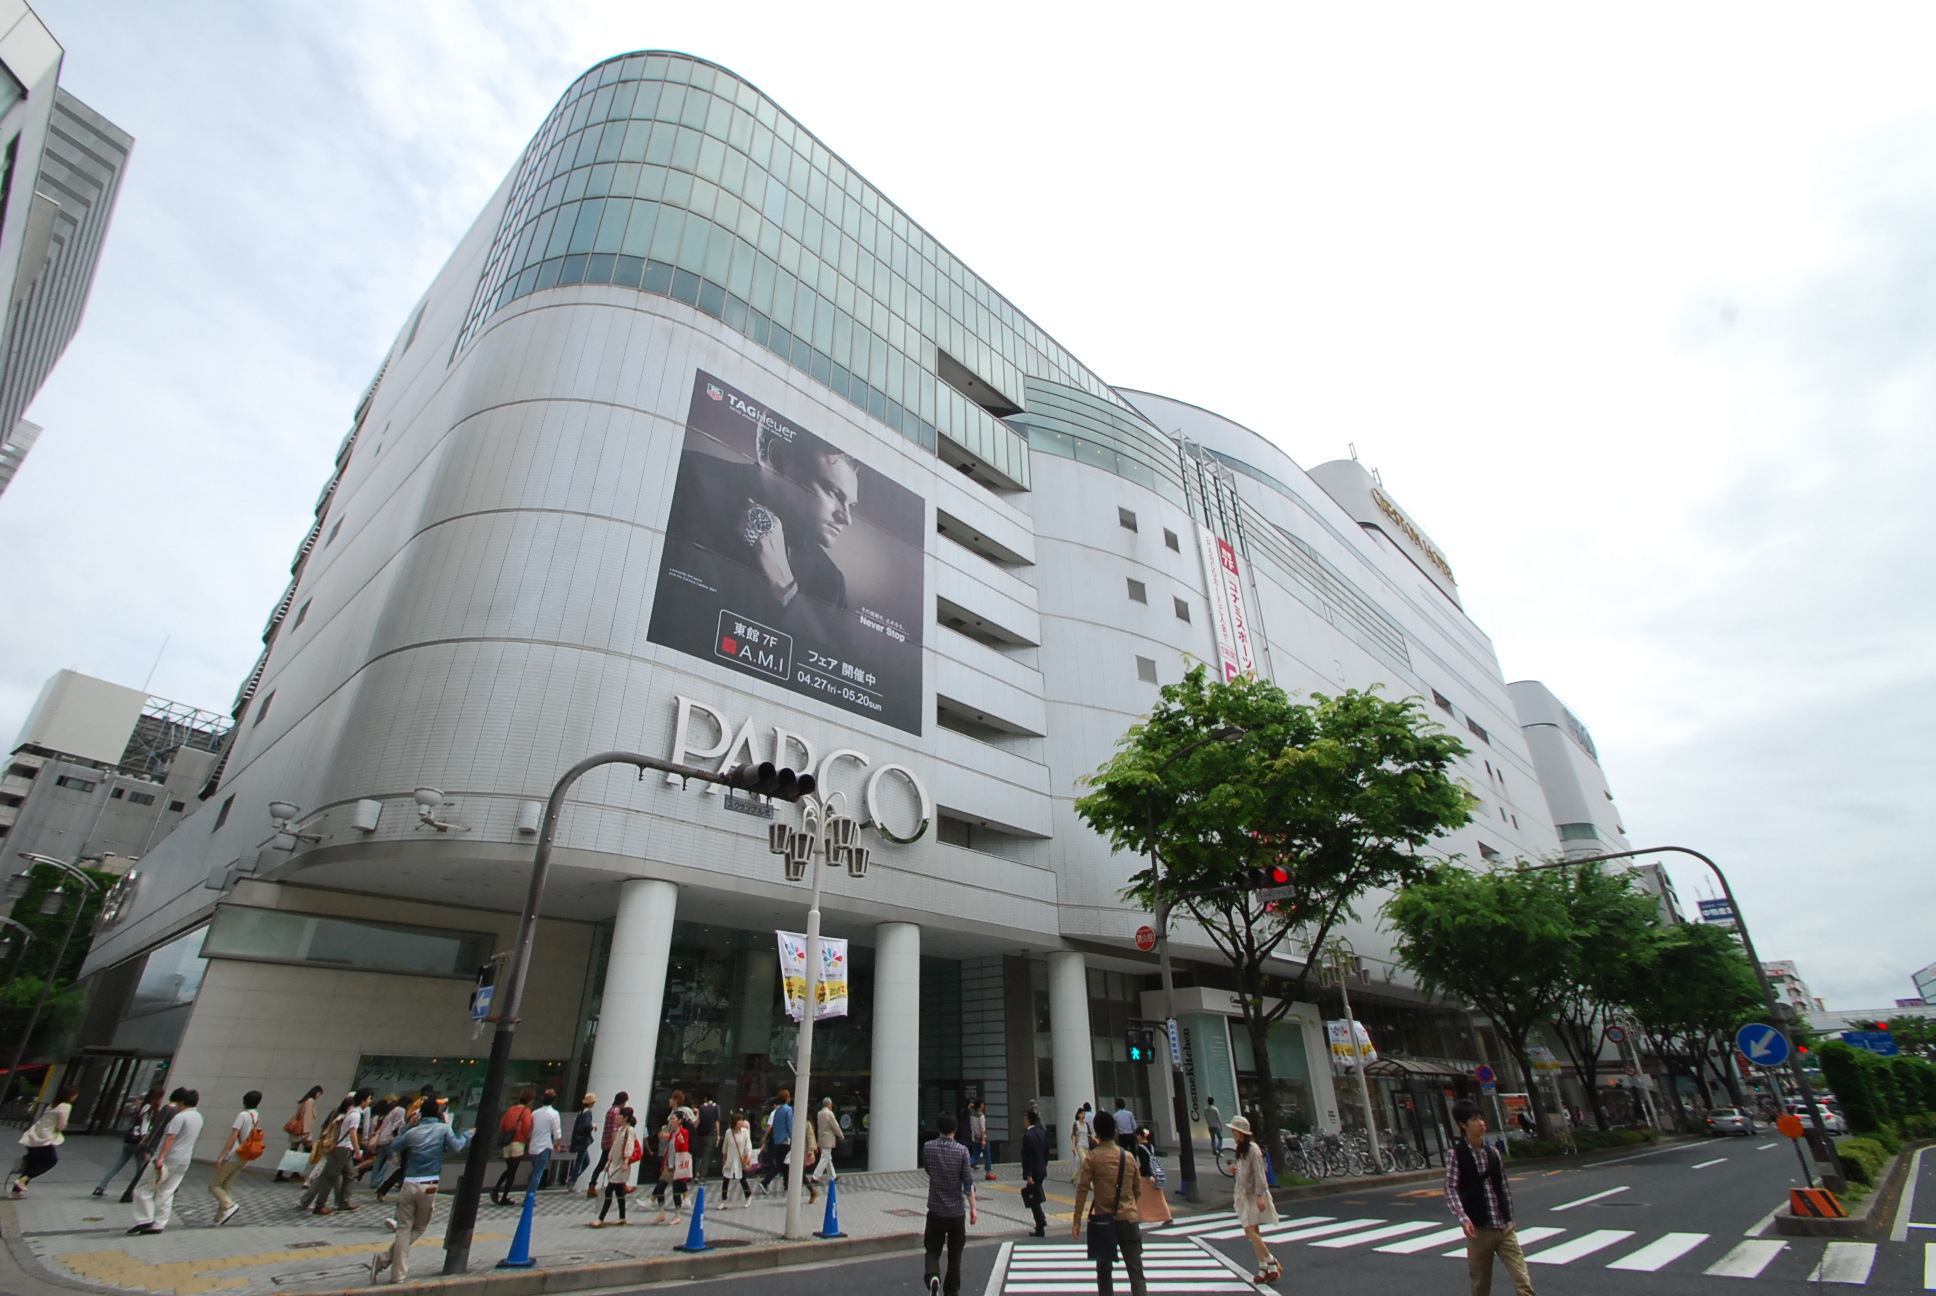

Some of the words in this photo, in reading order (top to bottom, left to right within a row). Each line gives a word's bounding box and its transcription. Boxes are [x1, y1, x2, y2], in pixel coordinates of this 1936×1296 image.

[1222, 555, 1235, 570] 7F
[733, 621, 760, 643] 東館
[763, 633, 778, 648] 7F
[860, 614, 885, 633] Never
[886, 627, 906, 642] Stop
[808, 650, 838, 670] フェア
[841, 661, 876, 687] 開催中
